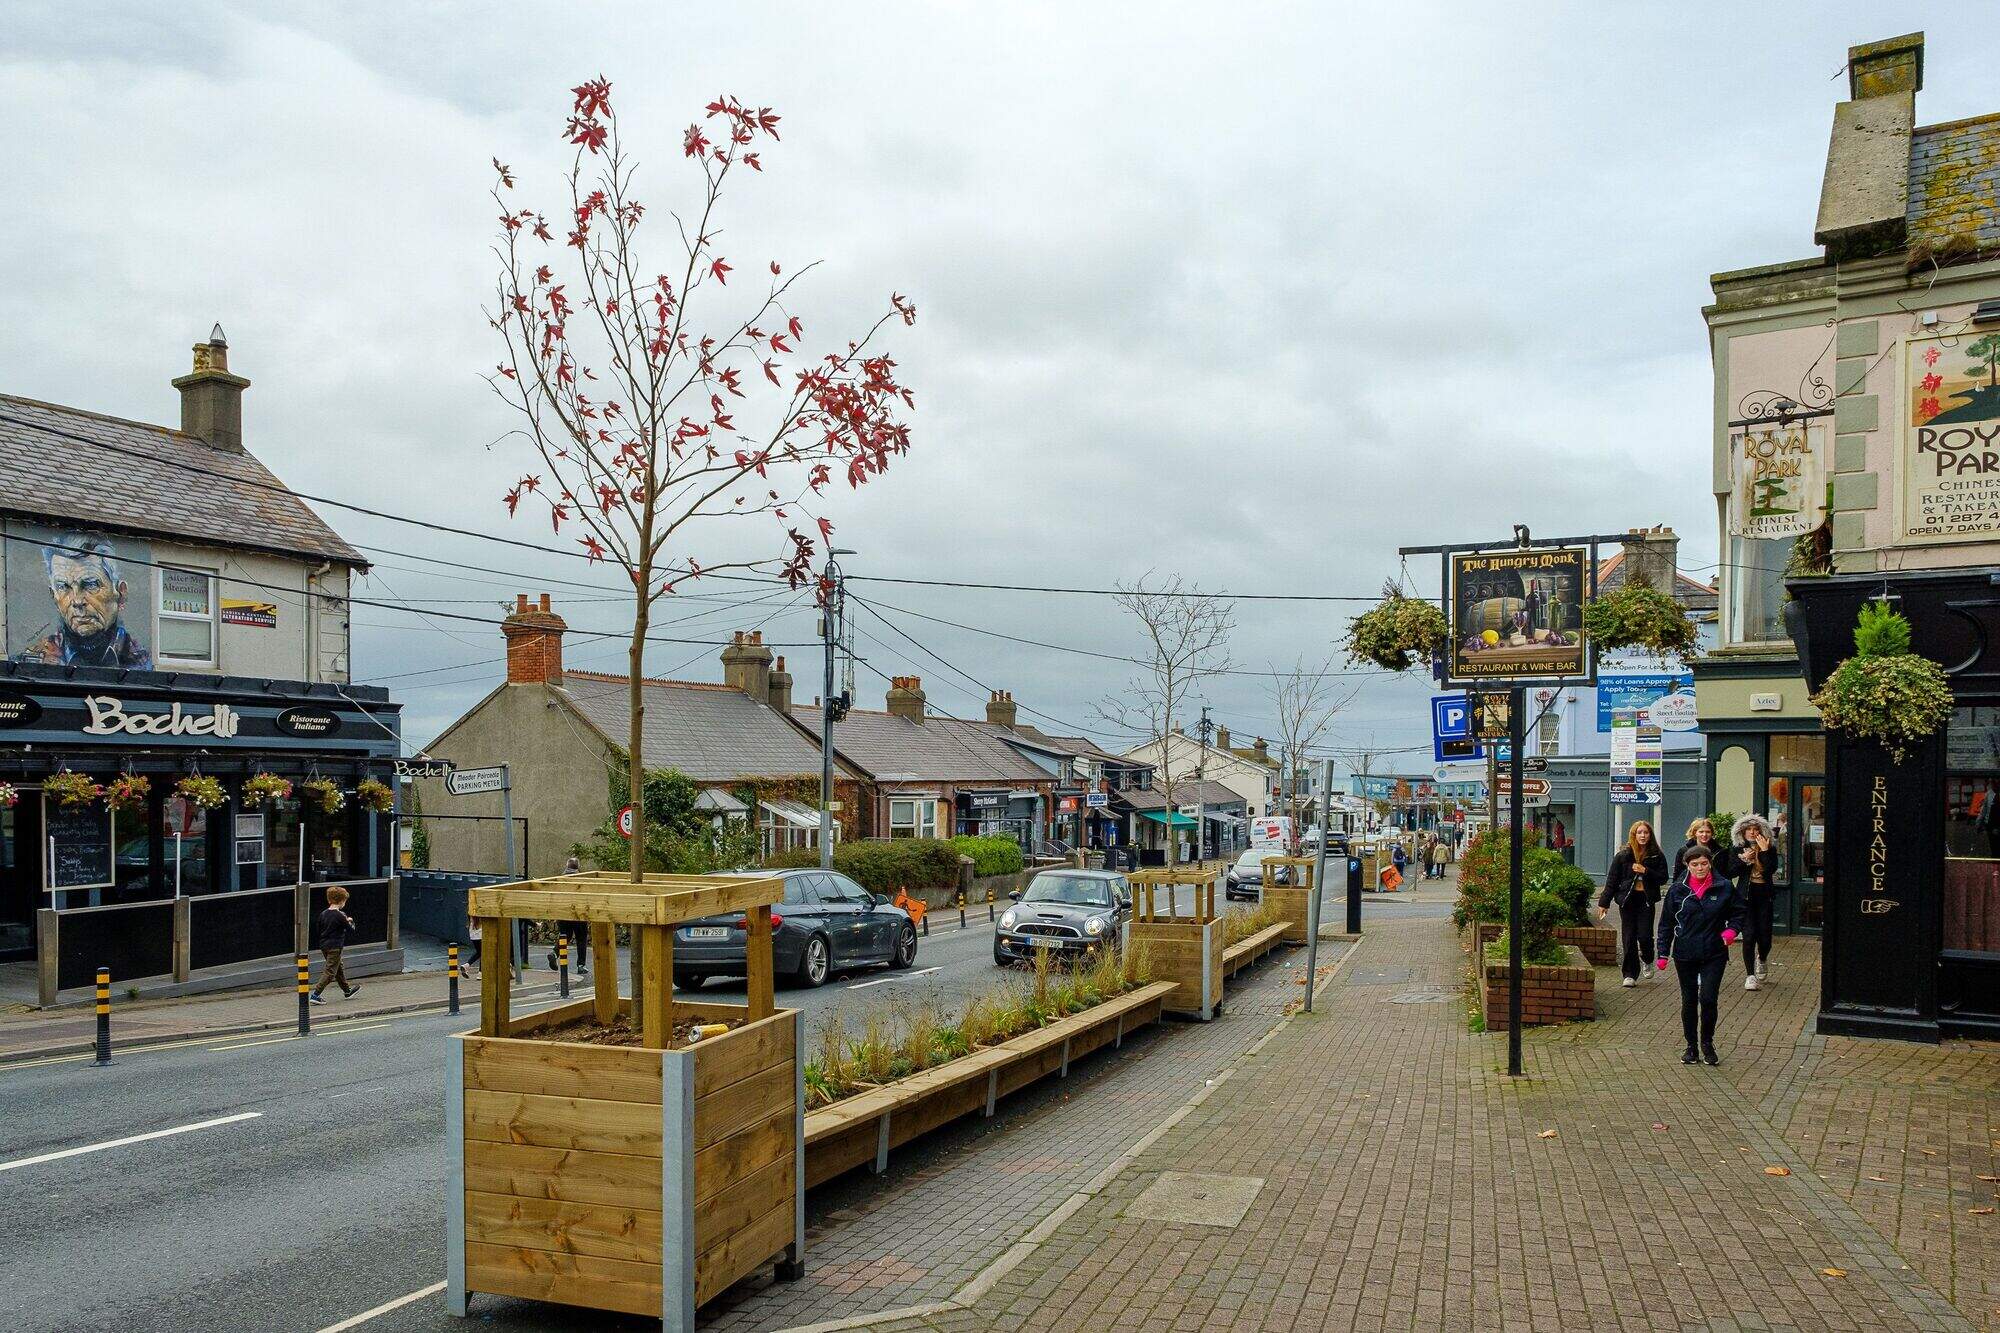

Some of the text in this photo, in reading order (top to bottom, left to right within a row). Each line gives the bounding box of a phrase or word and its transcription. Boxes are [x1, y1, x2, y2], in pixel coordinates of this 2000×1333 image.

[1918, 425, 2000, 453] ROY
[1744, 436, 1812, 458] ROYAL
[1754, 458, 1801, 480] PARK
[1936, 451, 2000, 476] PAR
[1922, 491, 2000, 504] RESTAUR
[1923, 501, 1998, 514] & TAKEA
[1926, 516, 1944, 524] 01
[1950, 513, 1983, 523] 287
[1909, 523, 1992, 535] OPEN 7 DAYS
[1488, 557, 1538, 571] Hungry
[1539, 552, 1579, 569] Monk
[1459, 663, 1520, 673] RESTAURANT
[1521, 663, 1528, 671] &
[1529, 662, 1555, 671] WINE
[1556, 661, 1577, 671] BAR
[1619, 664, 1636, 672] Open
[83, 695, 240, 738] Bochelli
[290, 715, 331, 724] Ristorante
[1447, 709, 1464, 727] P
[294, 722, 326, 730] Italiano
[457, 779, 500, 790] PARKING METER
[624, 814, 630, 826] 5
[1870, 776, 1888, 891] ENTRANCE
